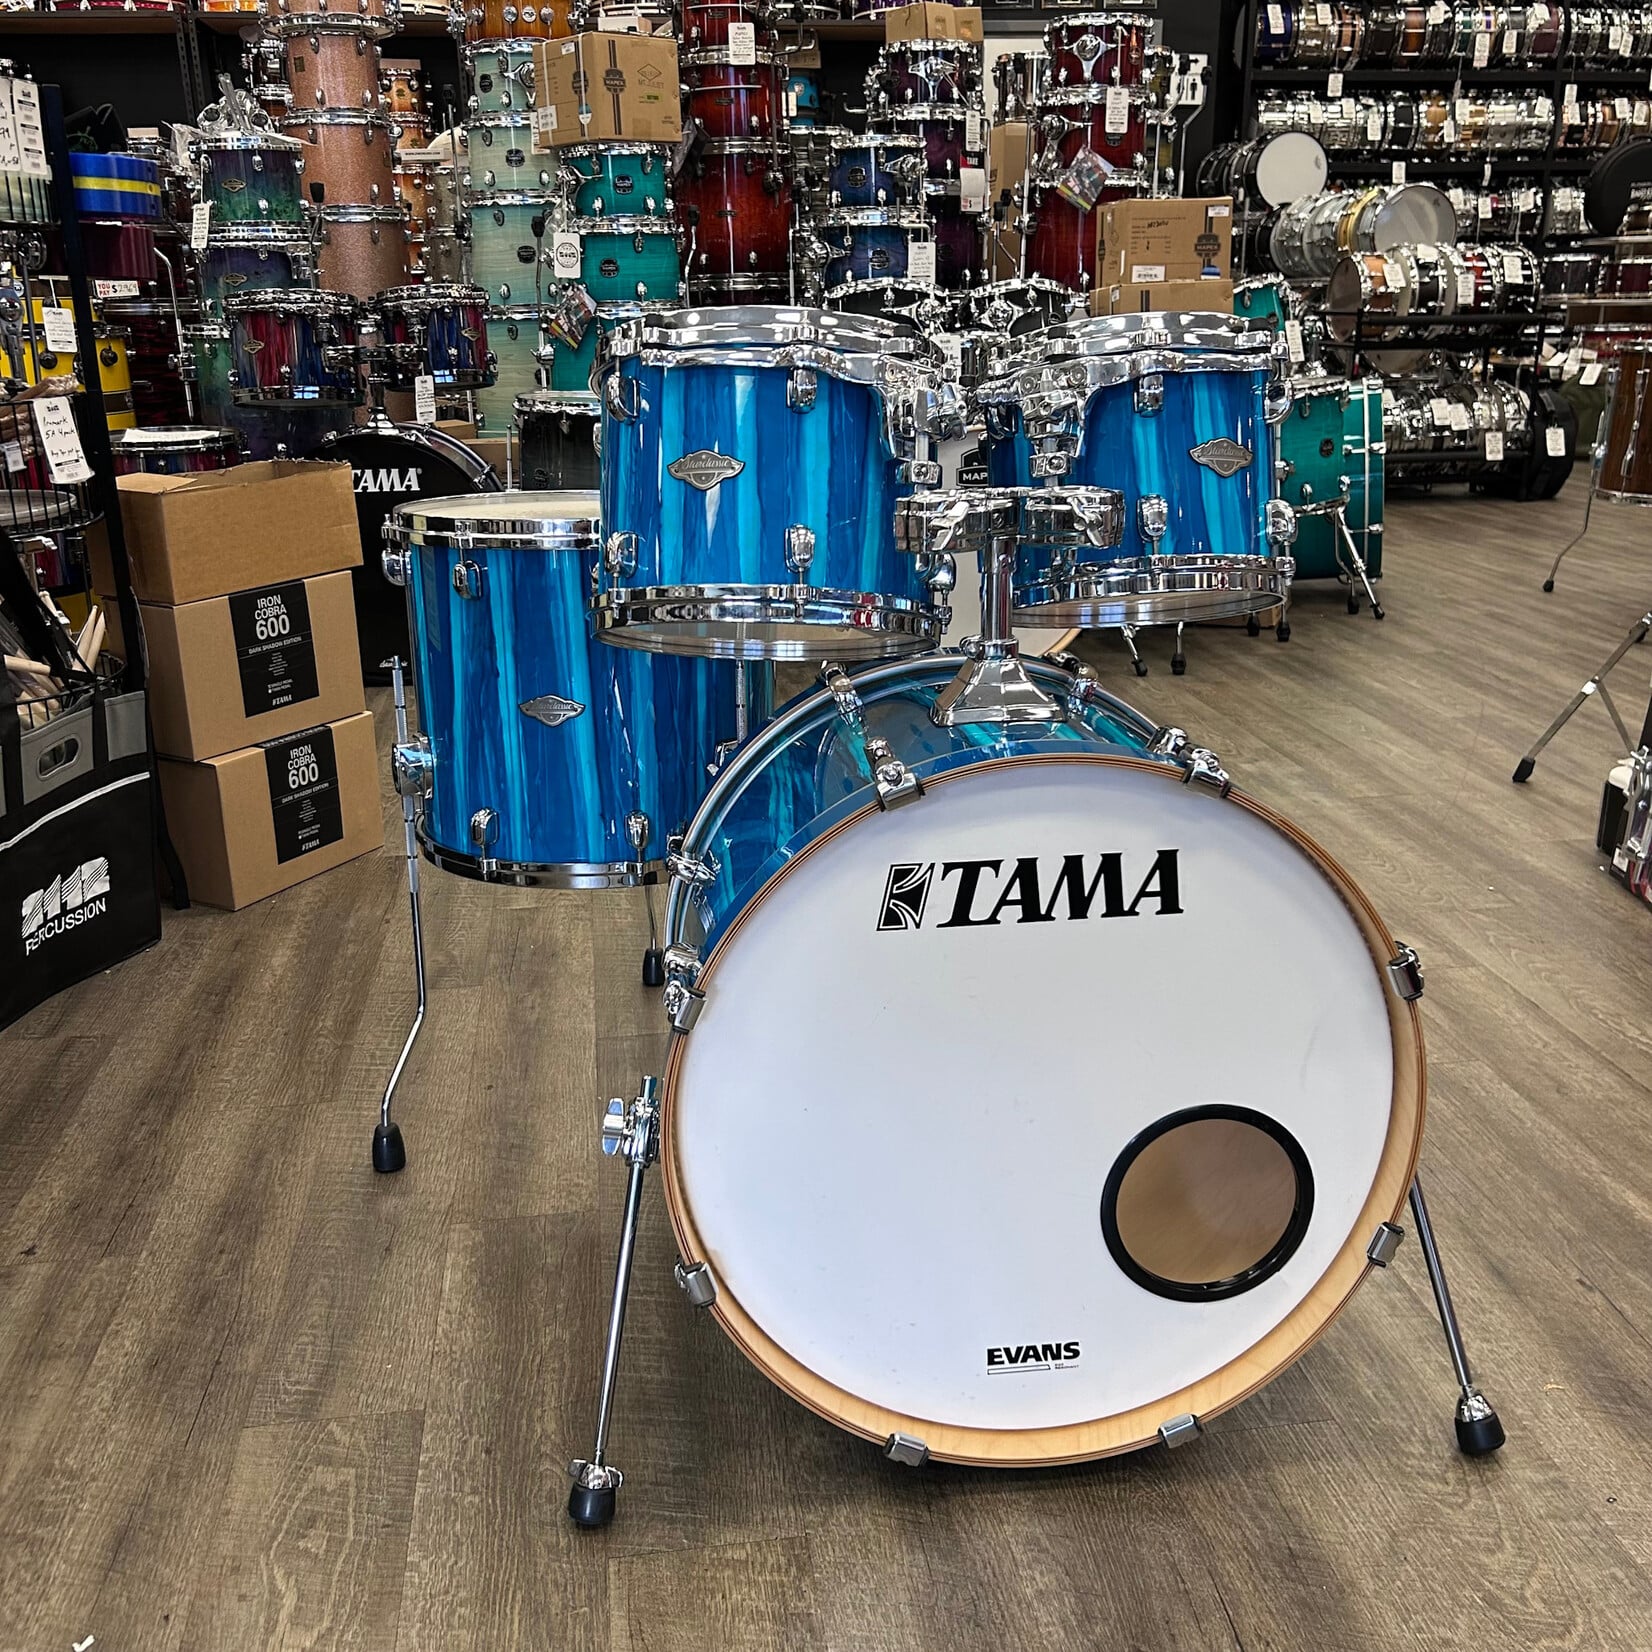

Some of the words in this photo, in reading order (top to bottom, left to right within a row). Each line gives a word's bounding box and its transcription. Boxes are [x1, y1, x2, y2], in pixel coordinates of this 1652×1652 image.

[962, 472, 988, 481] MAP
[257, 594, 281, 609] IRON
[254, 604, 287, 620] COBRA
[255, 614, 290, 640] 600
[248, 645, 262, 655] DARK
[262, 640, 283, 652] SHADOW
[283, 636, 302, 647] EDITION
[287, 753, 317, 770] COBRA
[290, 744, 312, 760] IRON
[288, 762, 319, 789] 600
[281, 795, 293, 804] DARK
[293, 788, 312, 799] SHADOW
[312, 782, 329, 792] EDITION
[936, 848, 1185, 929] TAMA
[25, 897, 107, 957] PERCUSSION
[986, 1341, 1081, 1366] EVANS
